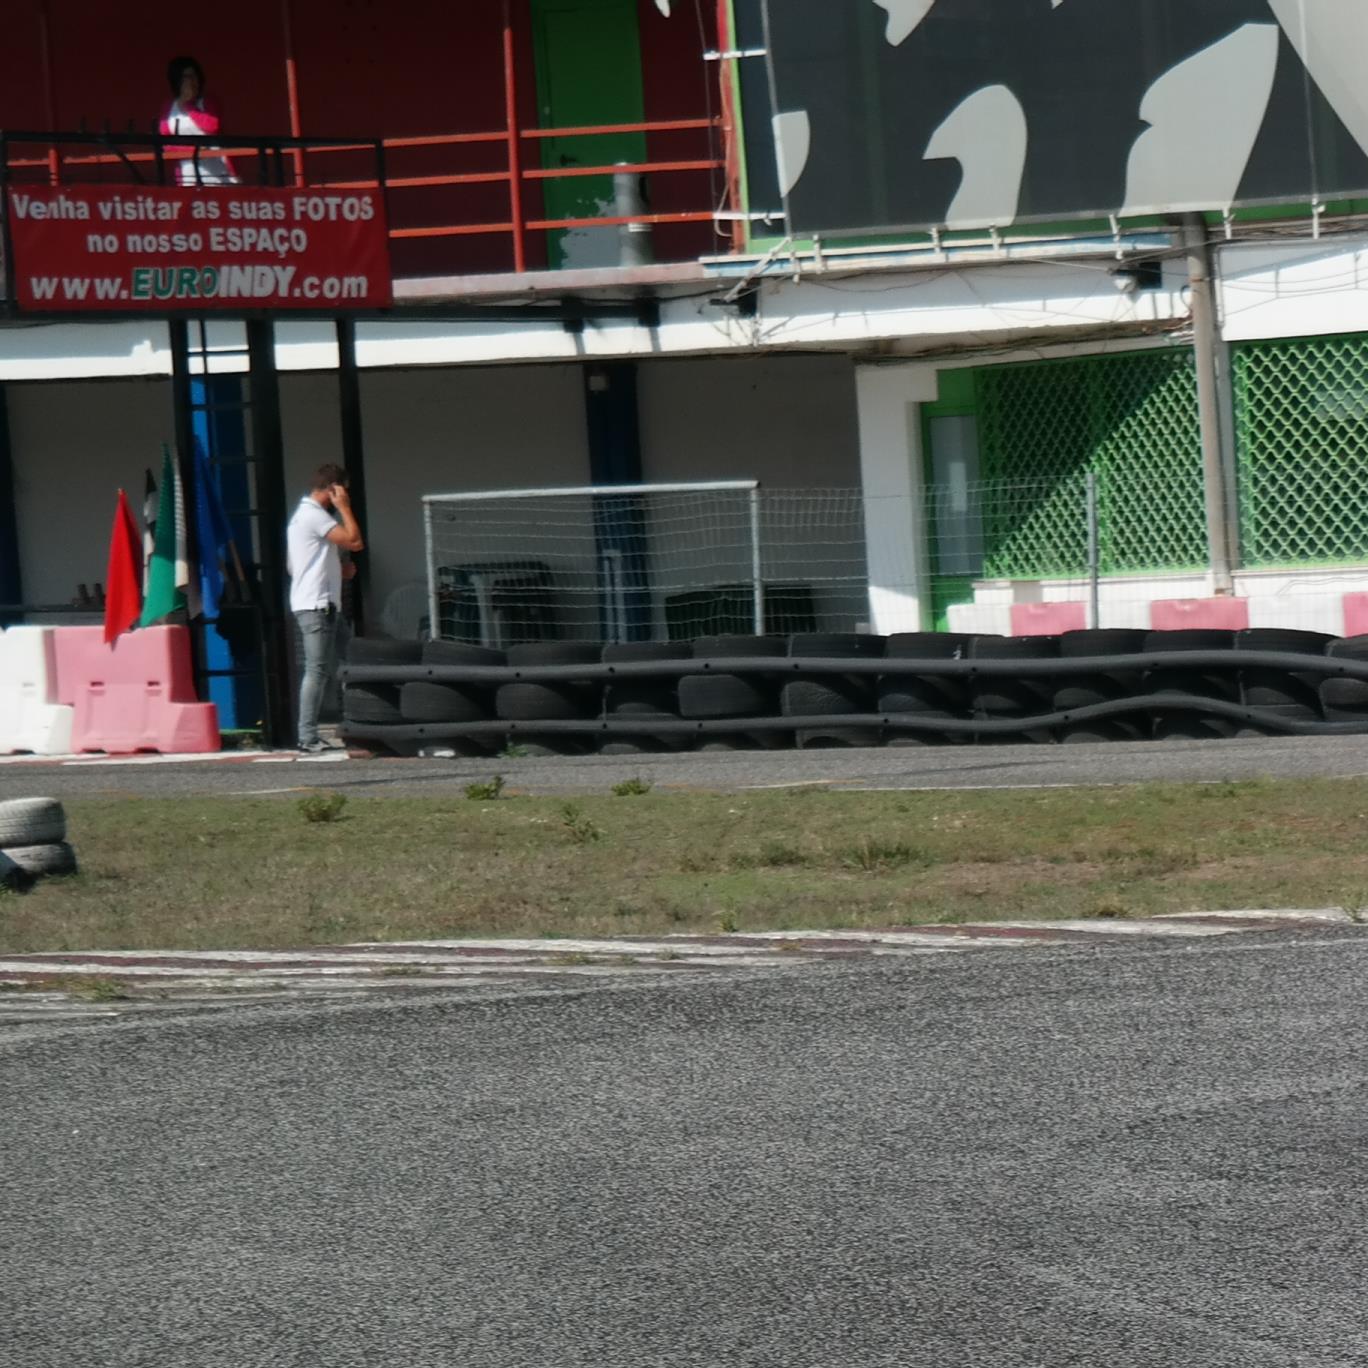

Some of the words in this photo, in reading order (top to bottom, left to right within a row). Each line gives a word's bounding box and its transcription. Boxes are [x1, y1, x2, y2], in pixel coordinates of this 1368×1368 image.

[12, 195, 90, 219] Venha
[98, 197, 182, 220] visitar
[192, 201, 220, 219] as
[228, 201, 286, 219] suas
[293, 197, 374, 220] FOTOS
[87, 234, 119, 252] no
[127, 233, 202, 252] nosso
[209, 228, 307, 258] ESPAÇO
[30, 265, 368, 300] www.EUROINDY.com
